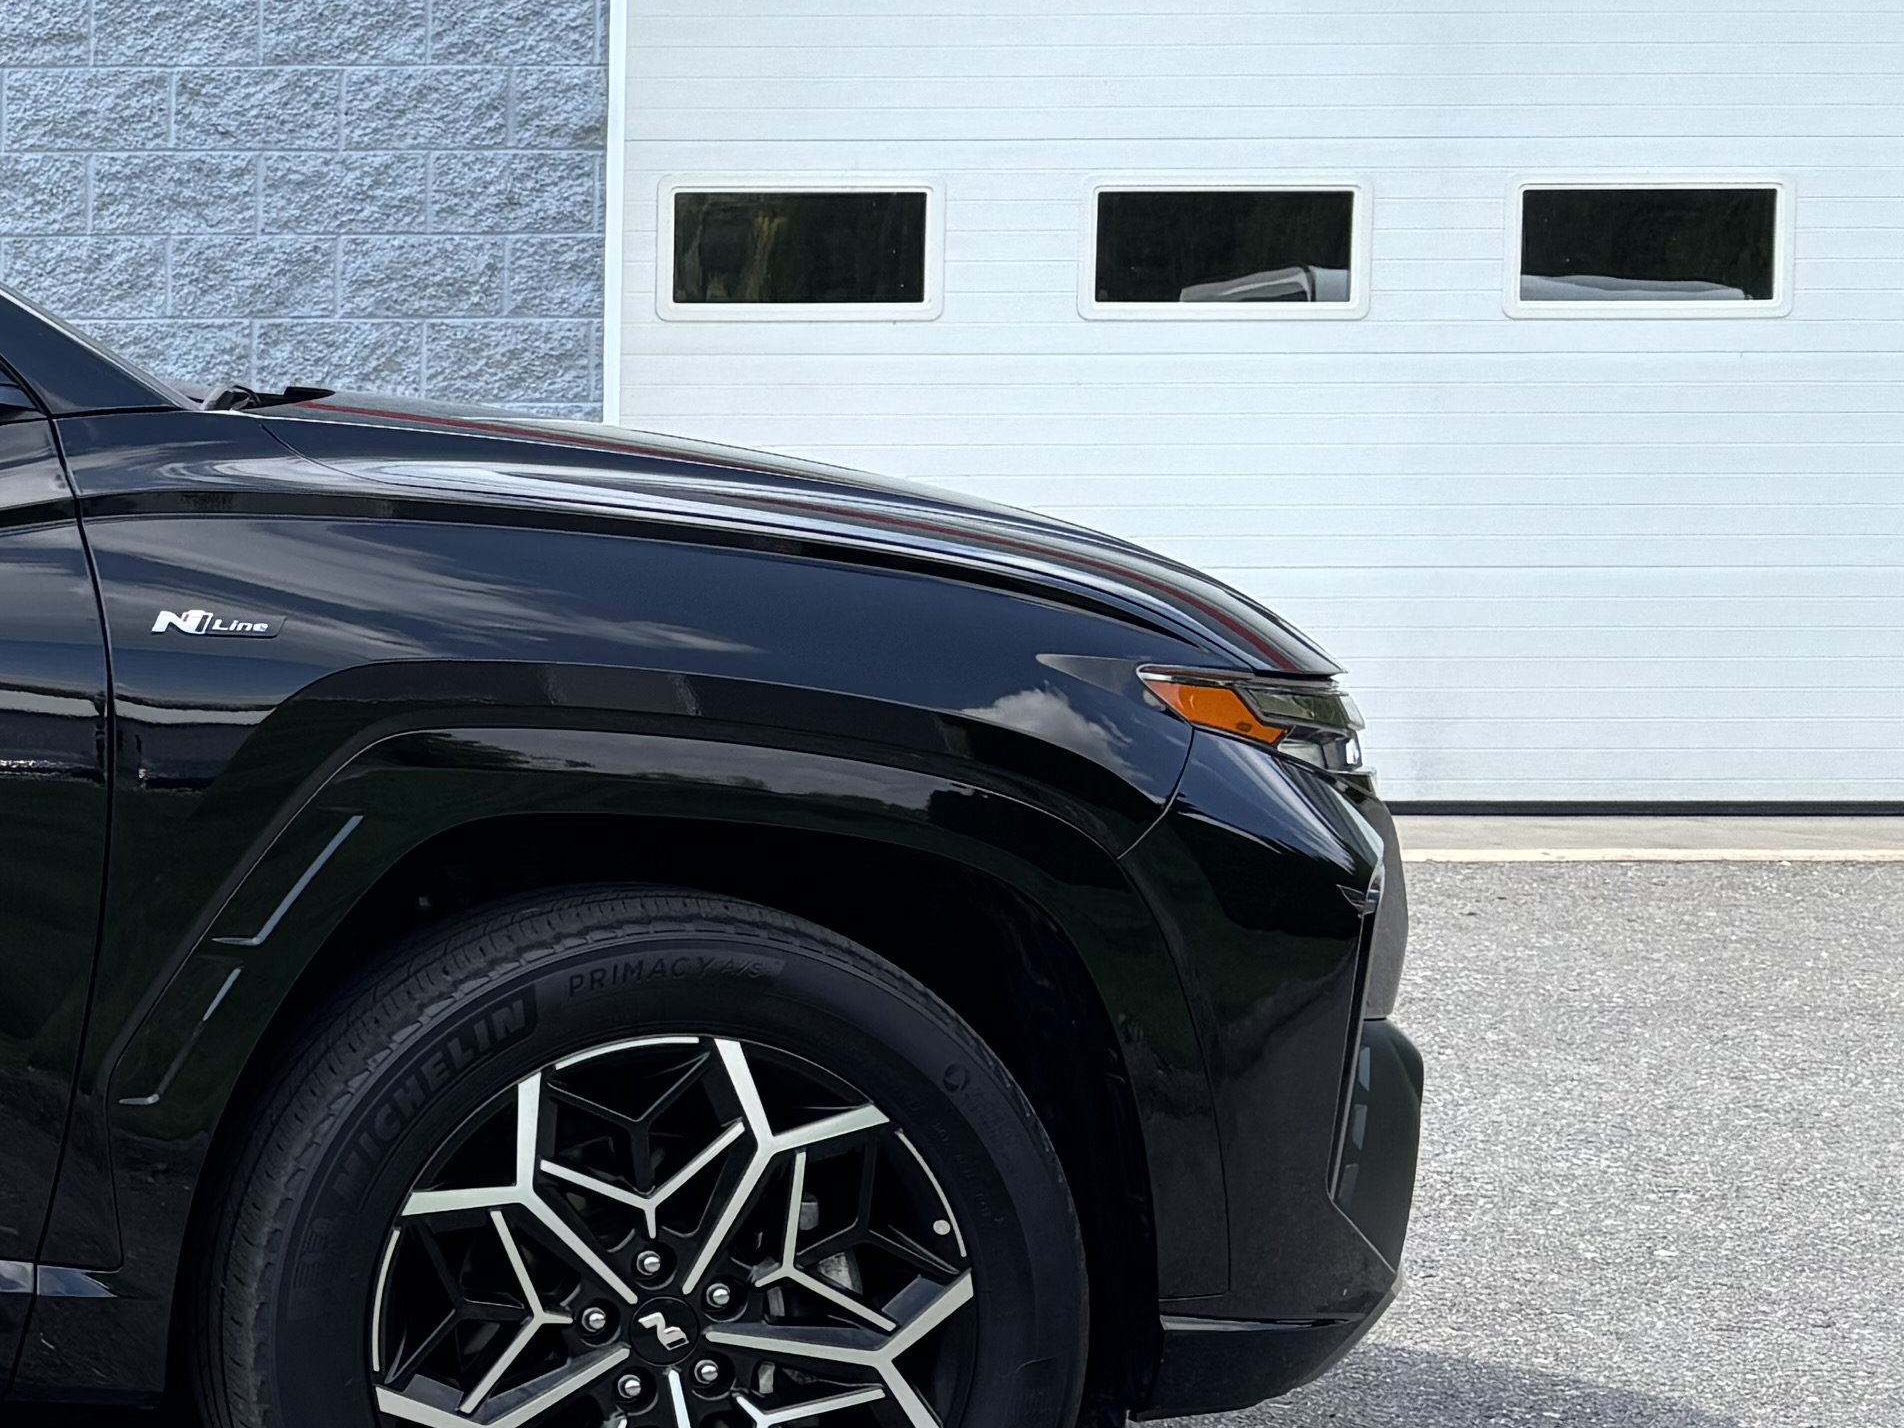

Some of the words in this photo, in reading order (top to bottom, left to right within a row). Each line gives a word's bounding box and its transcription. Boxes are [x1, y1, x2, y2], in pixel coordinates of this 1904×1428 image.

[212, 619, 268, 632] Line
[563, 956, 714, 996] PRIMACY
[331, 998, 533, 1202] MICHELIN
